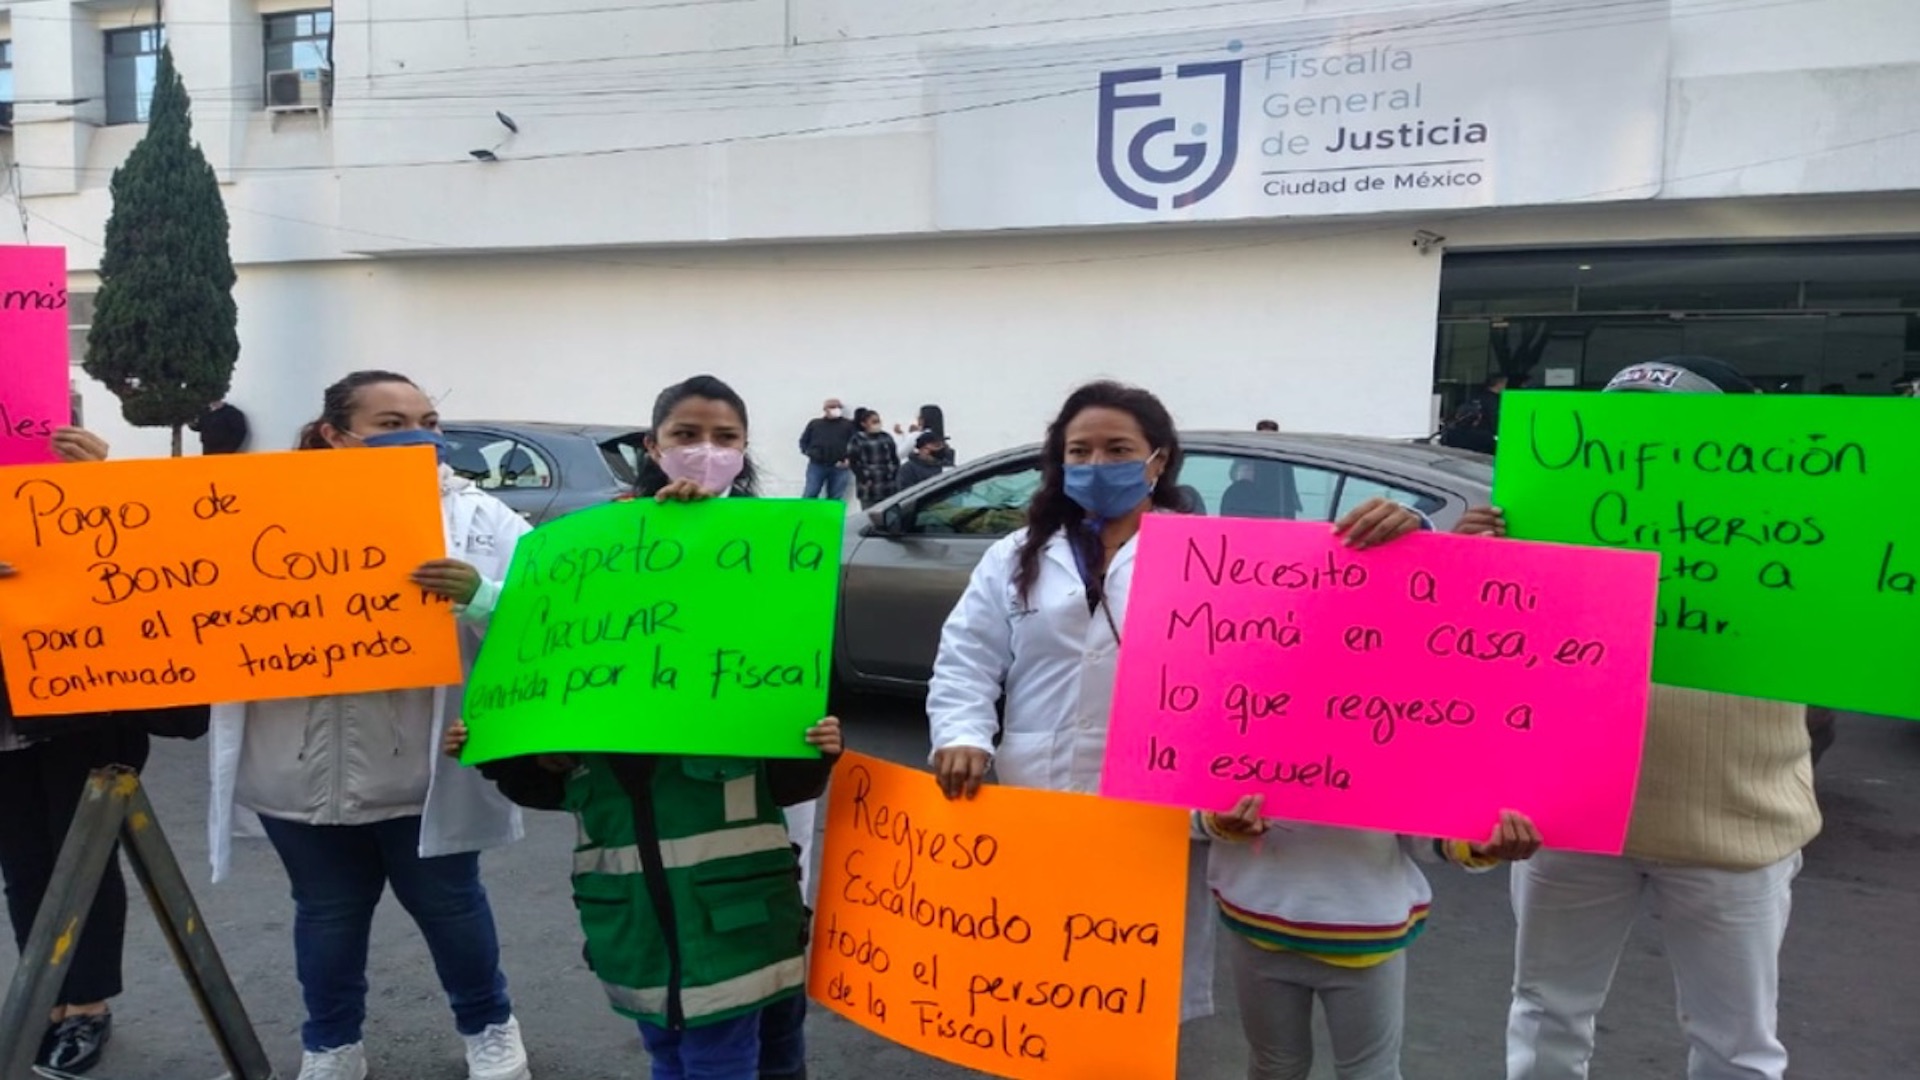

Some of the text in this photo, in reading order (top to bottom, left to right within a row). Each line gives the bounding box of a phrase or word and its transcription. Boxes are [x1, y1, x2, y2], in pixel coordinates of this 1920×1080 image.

[1264, 44, 1413, 81] Fiscalía
[1262, 82, 1422, 119] General
[1261, 117, 1488, 157] de Justicia
[1264, 168, 1482, 197] Ciudad de México
[1530, 409, 1867, 491] Unificación
[15, 479, 240, 558] Pago de
[1590, 490, 1825, 548] Criterios
[87, 559, 219, 605] BONO
[521, 514, 823, 603] Respeto a la
[1184, 533, 1538, 612] Necesito a mi
[1757, 560, 1795, 591] a
[1877, 541, 1919, 594] la
[22, 626, 104, 670] para
[141, 611, 171, 640] el
[191, 594, 324, 645] personal
[346, 592, 401, 623] que
[1167, 601, 1301, 656] Mamá
[1344, 625, 1383, 652] en
[1553, 636, 1606, 666] en
[29, 664, 197, 700] continuado
[561, 661, 627, 705] por
[652, 645, 677, 690] la
[710, 647, 823, 698] Fiscal
[1159, 664, 1533, 745] lo que regreso a
[1148, 735, 1352, 791] la escuela
[849, 764, 998, 888] Regreso
[843, 849, 1159, 961] Escalonado para
[827, 913, 1146, 1017] todo el personal
[828, 971, 855, 1008] de
[867, 981, 887, 1024] la
